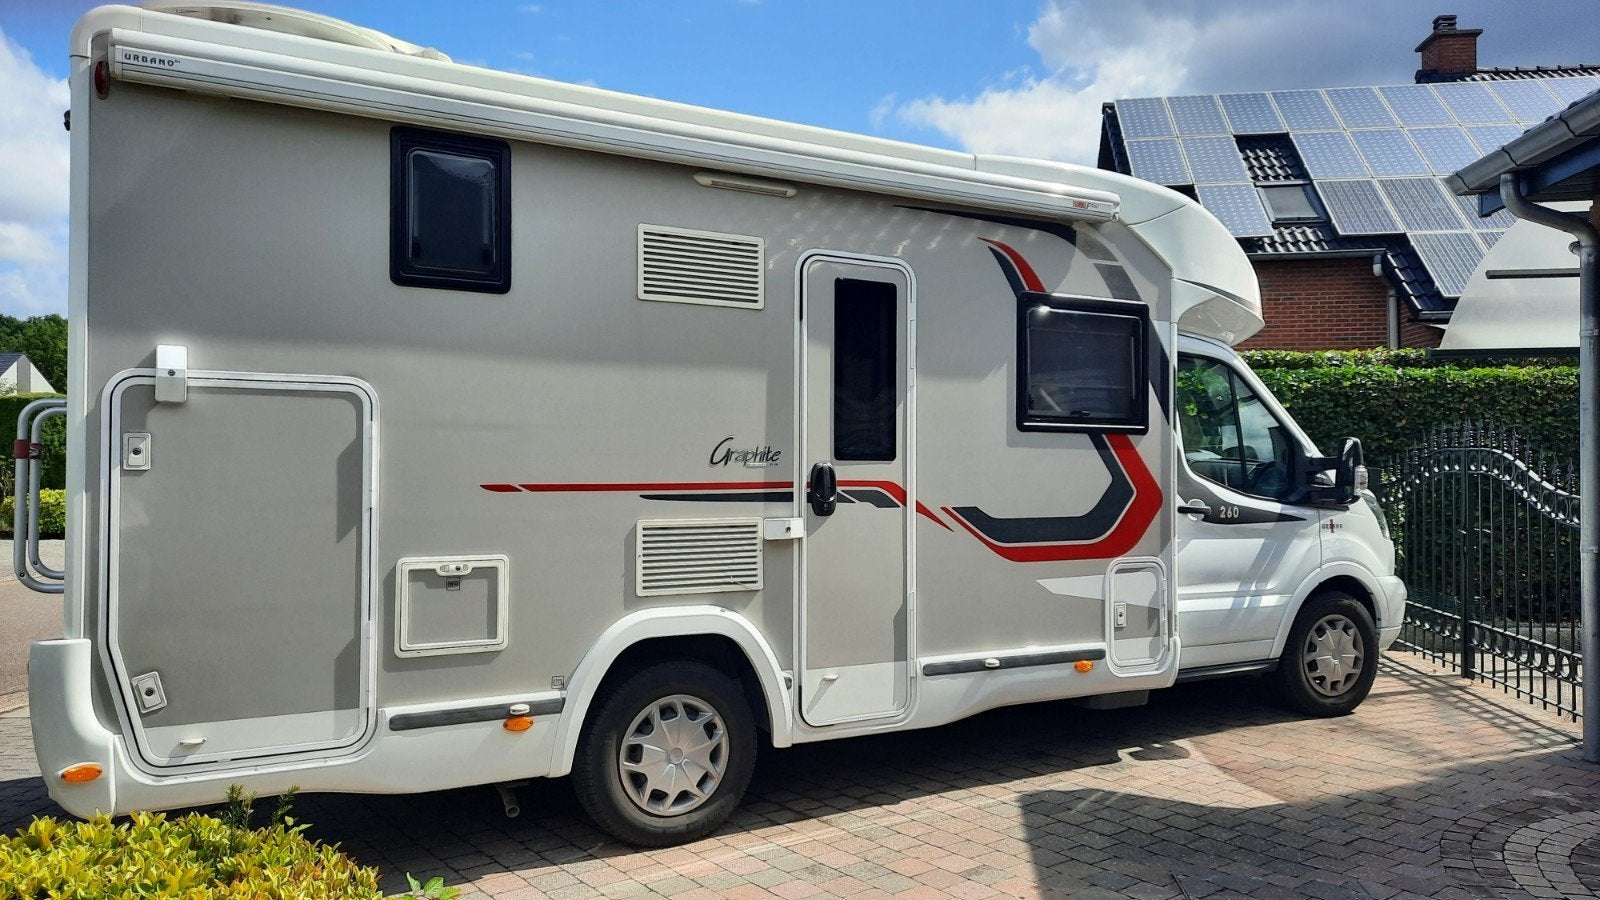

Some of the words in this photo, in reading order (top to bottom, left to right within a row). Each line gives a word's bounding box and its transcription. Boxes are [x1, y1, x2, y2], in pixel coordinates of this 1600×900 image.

[124, 53, 174, 67] URBANO
[710, 436, 782, 467] Graphite
[1220, 505, 1240, 519] 260
